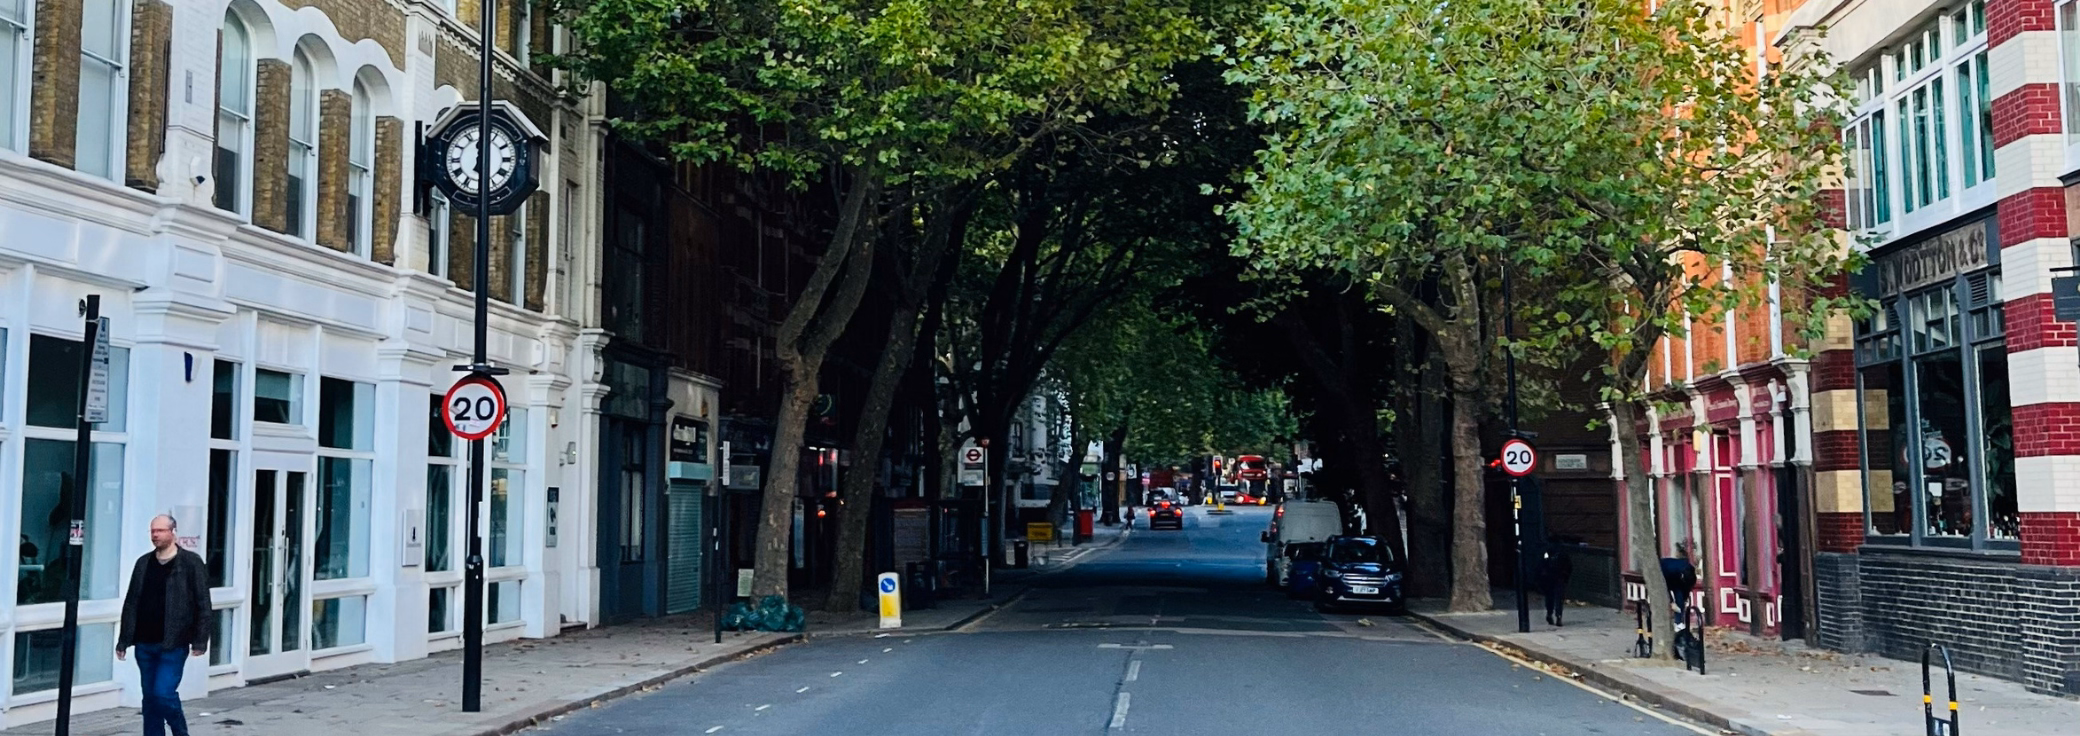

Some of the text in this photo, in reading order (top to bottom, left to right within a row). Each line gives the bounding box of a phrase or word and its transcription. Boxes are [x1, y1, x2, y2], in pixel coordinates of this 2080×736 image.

[1958, 238, 1969, 268] &
[454, 396, 495, 420] 20
[1507, 450, 1531, 465] 20
